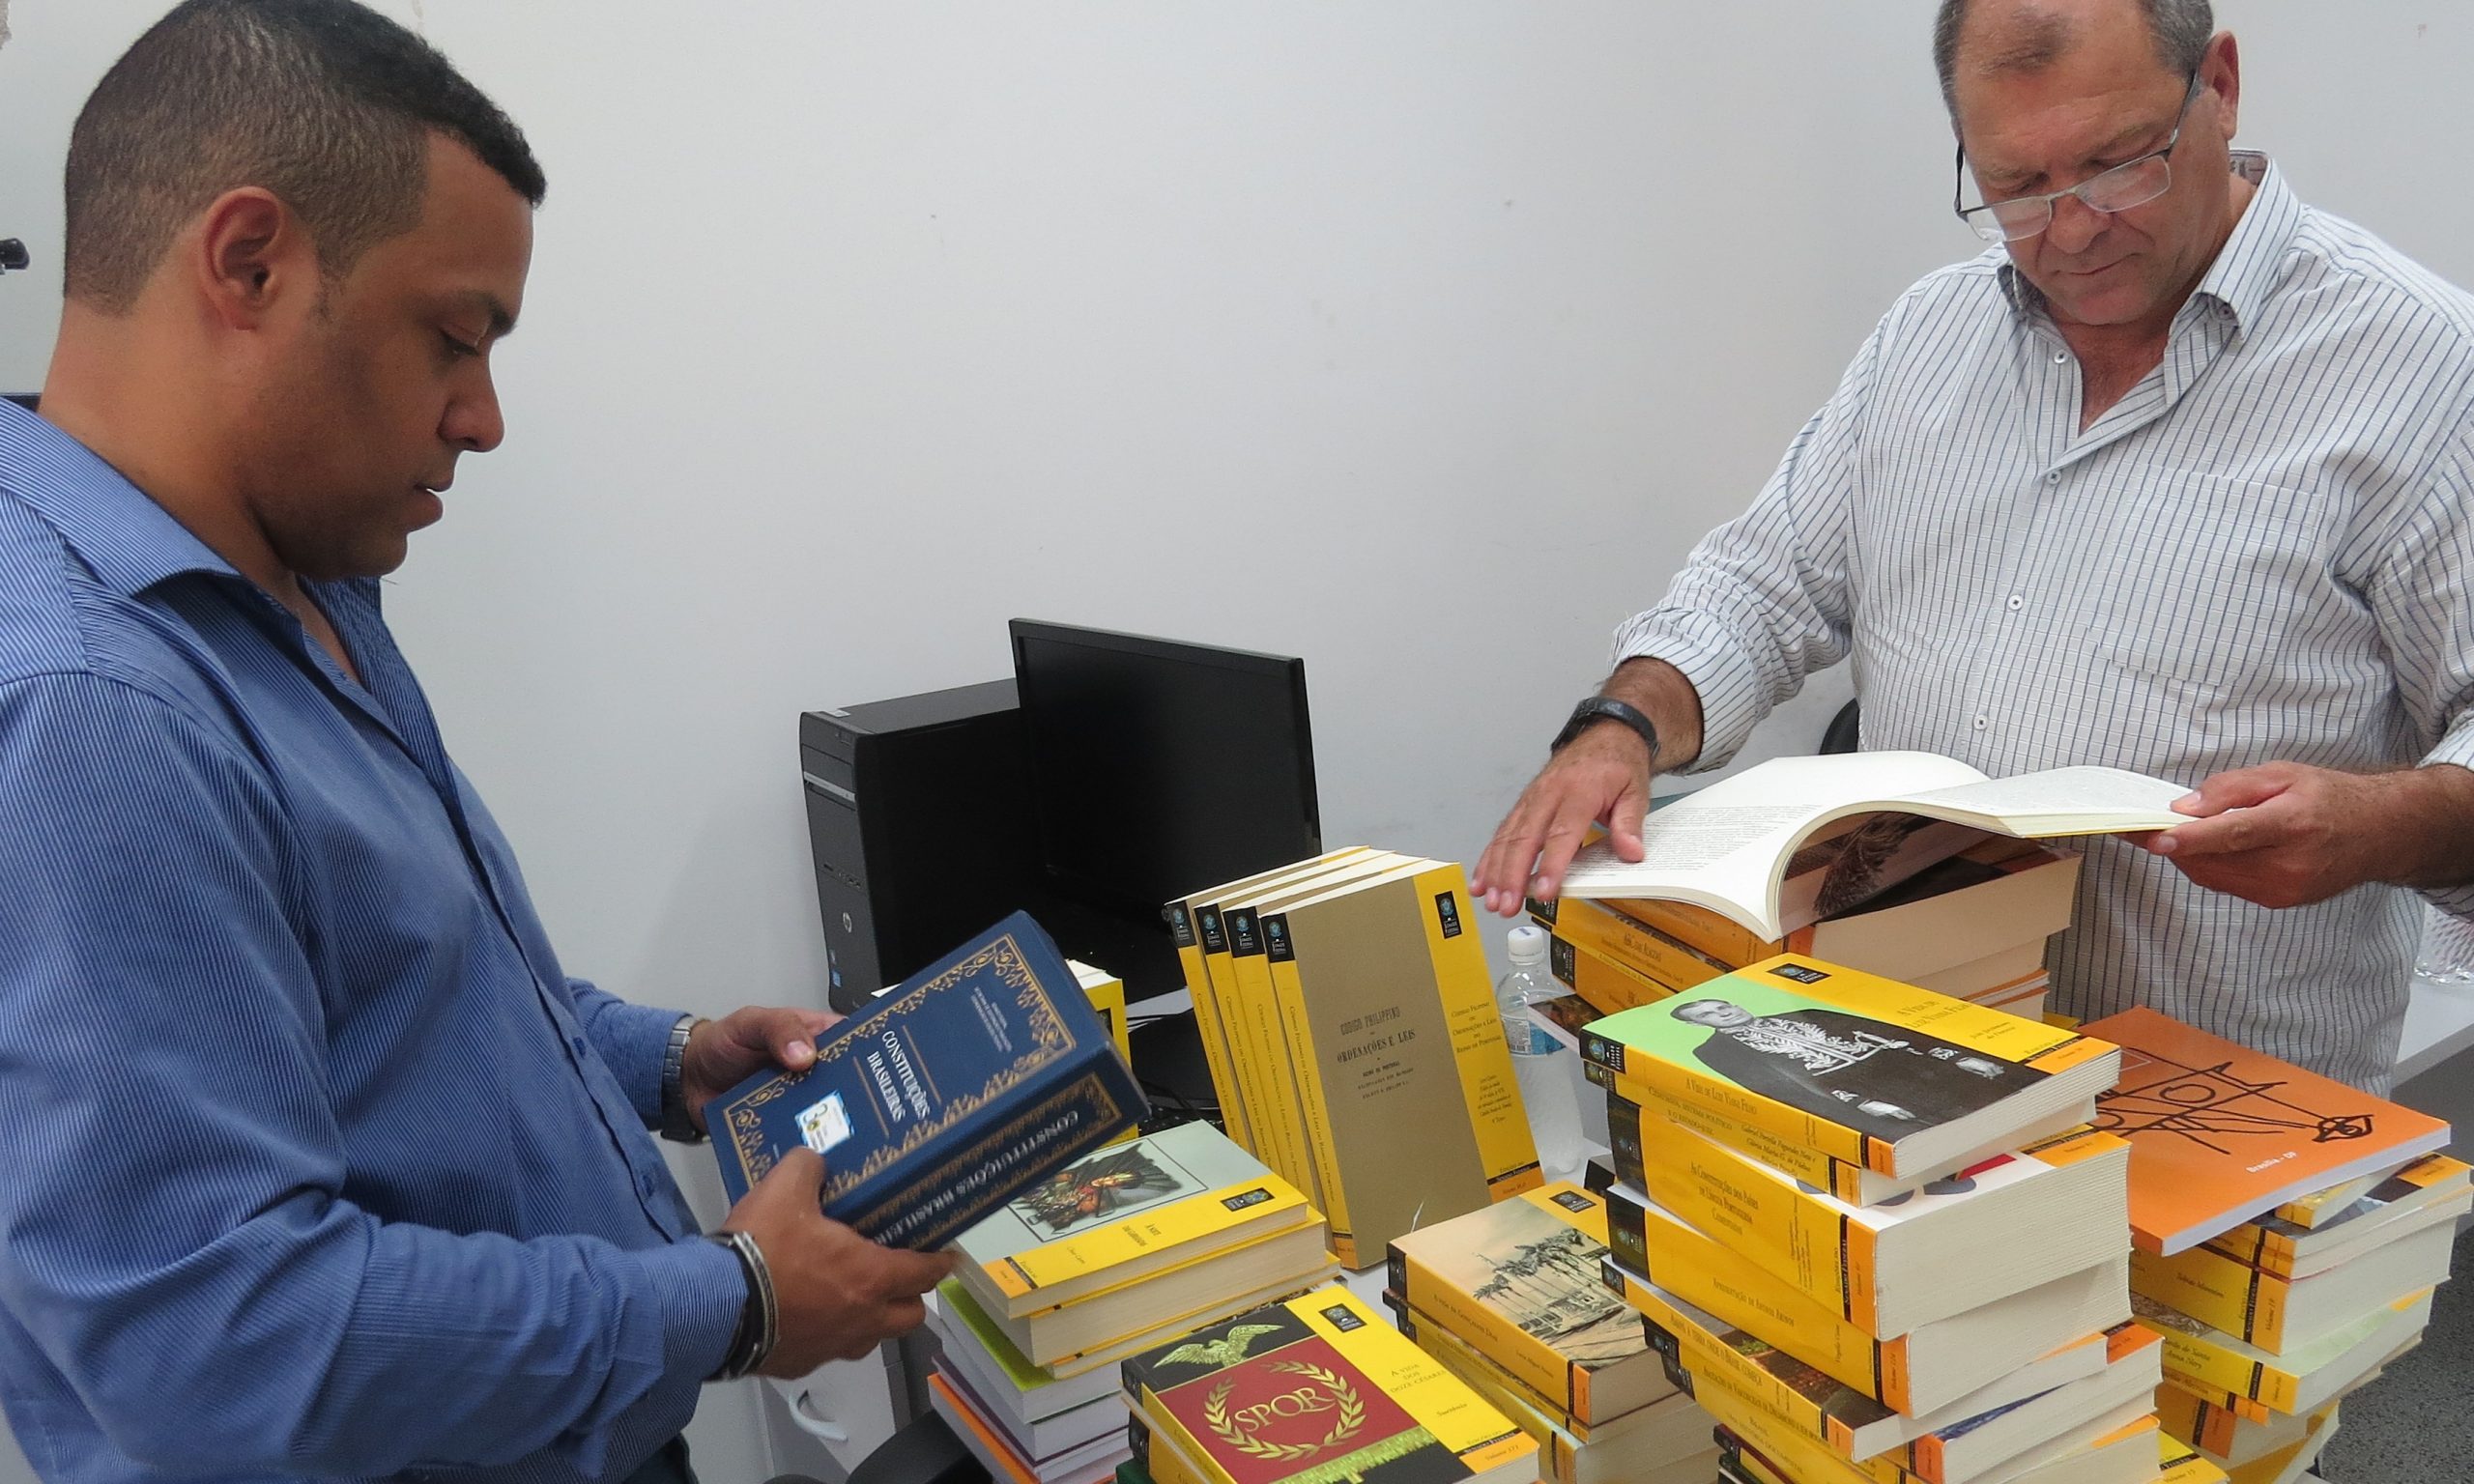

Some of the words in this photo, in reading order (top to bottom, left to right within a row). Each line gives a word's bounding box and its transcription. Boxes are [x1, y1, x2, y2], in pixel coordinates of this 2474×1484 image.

[867, 1050, 906, 1123] BRASILEIRAS
[881, 1030, 931, 1122] CONSTITUIÇÕES
[1337, 1040, 1387, 1064] ORDENAÇÕES
[955, 1109, 1079, 1198] CONSTITUIÇÕES
[1234, 1386, 1336, 1433] SPQR
